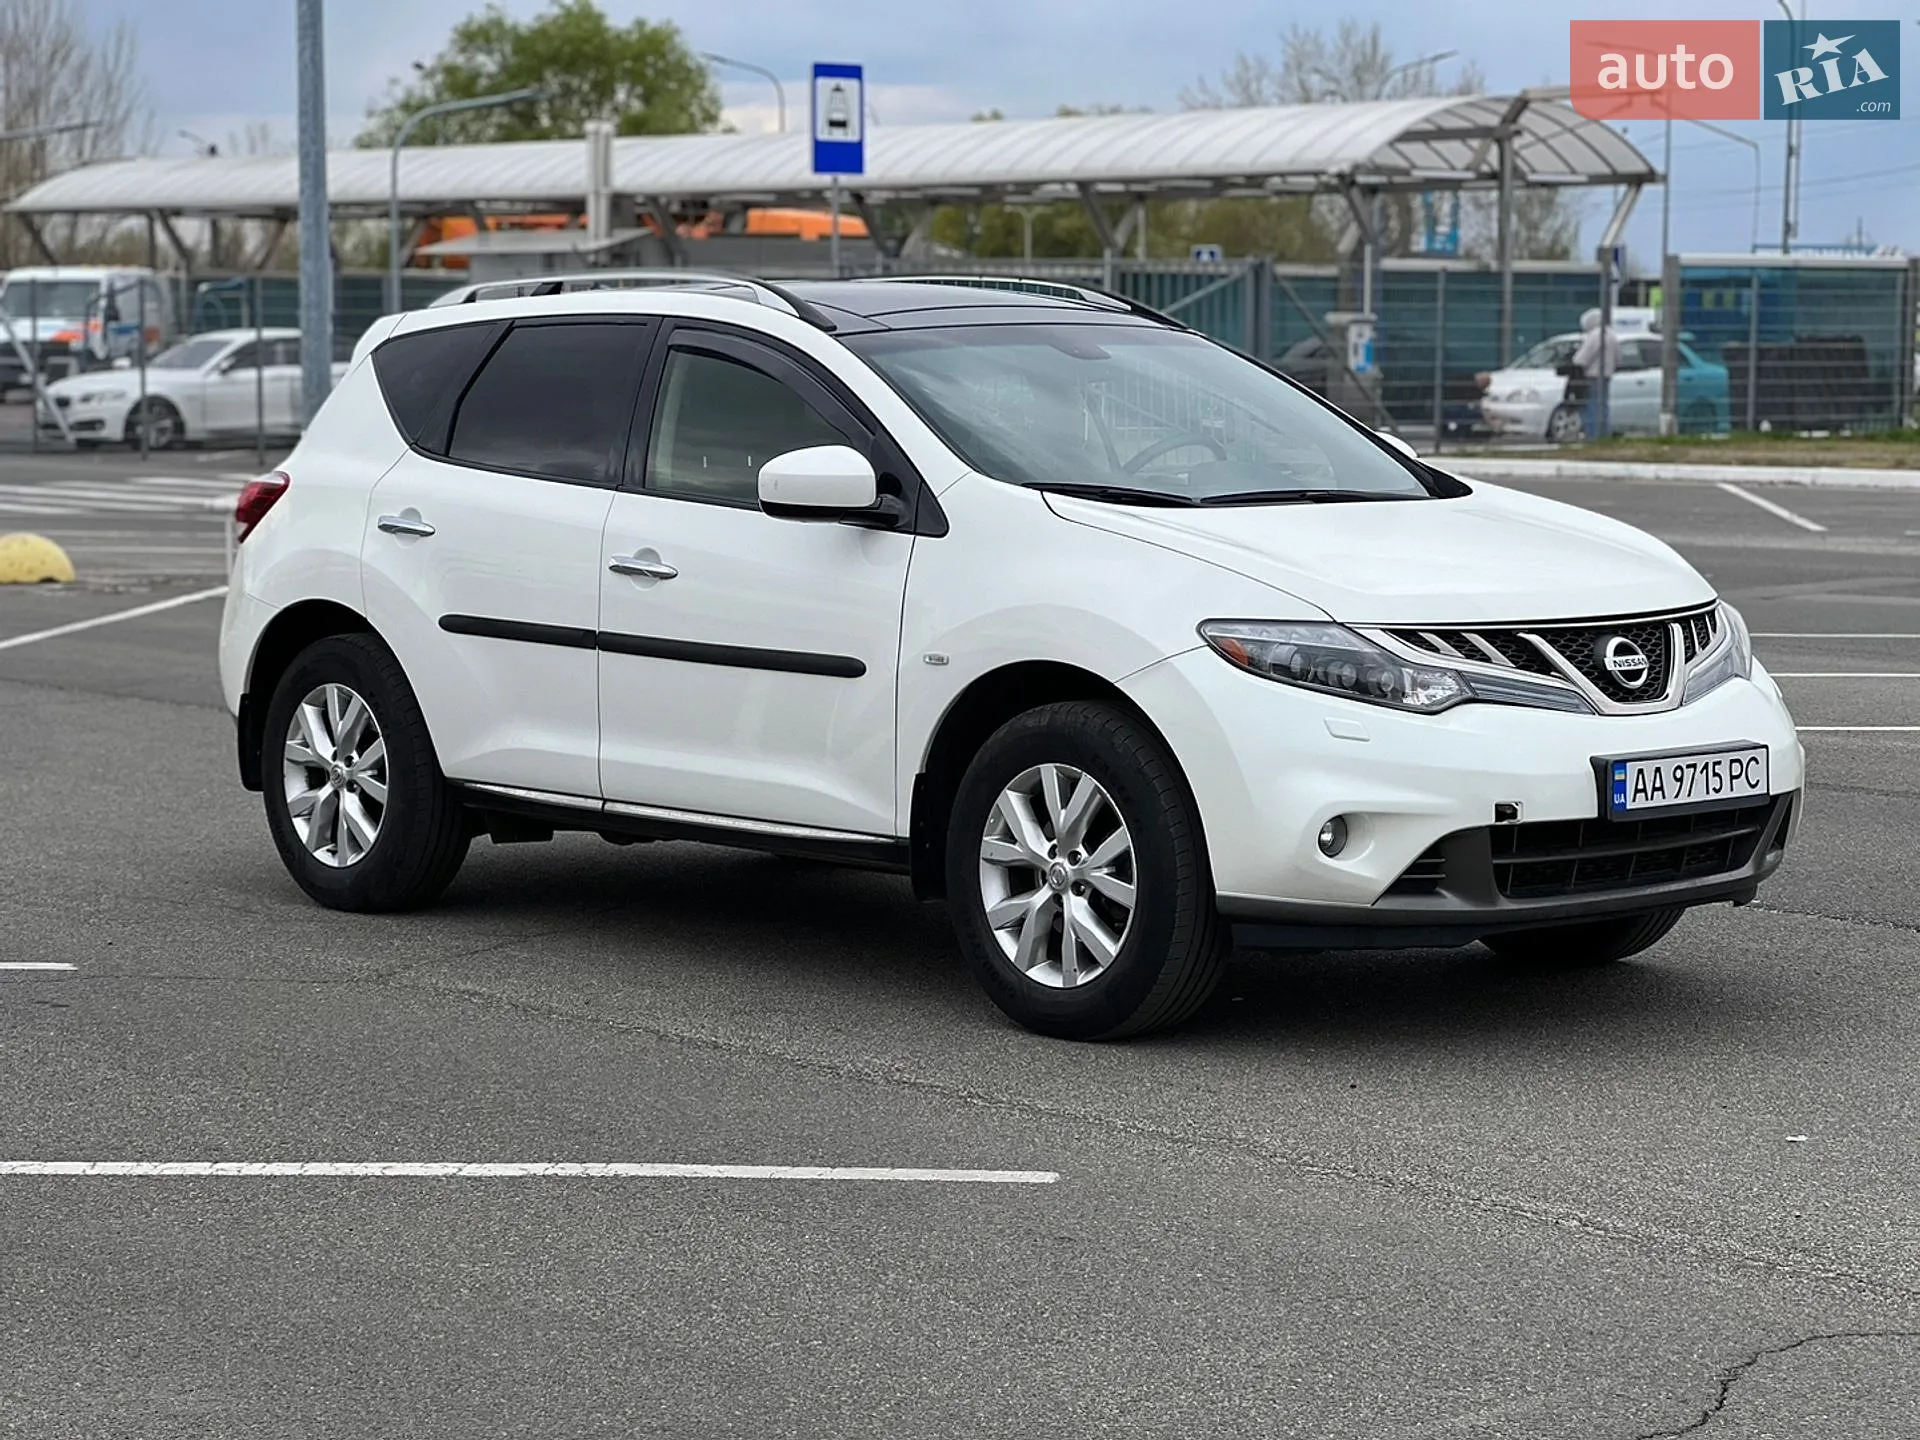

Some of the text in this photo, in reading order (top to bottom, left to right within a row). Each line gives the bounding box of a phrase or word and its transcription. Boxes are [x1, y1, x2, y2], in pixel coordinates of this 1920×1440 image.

[1612, 656, 1649, 668] NISSAN
[1632, 756, 1760, 803] AA 9715 PC
[1614, 793, 1625, 804] UA
